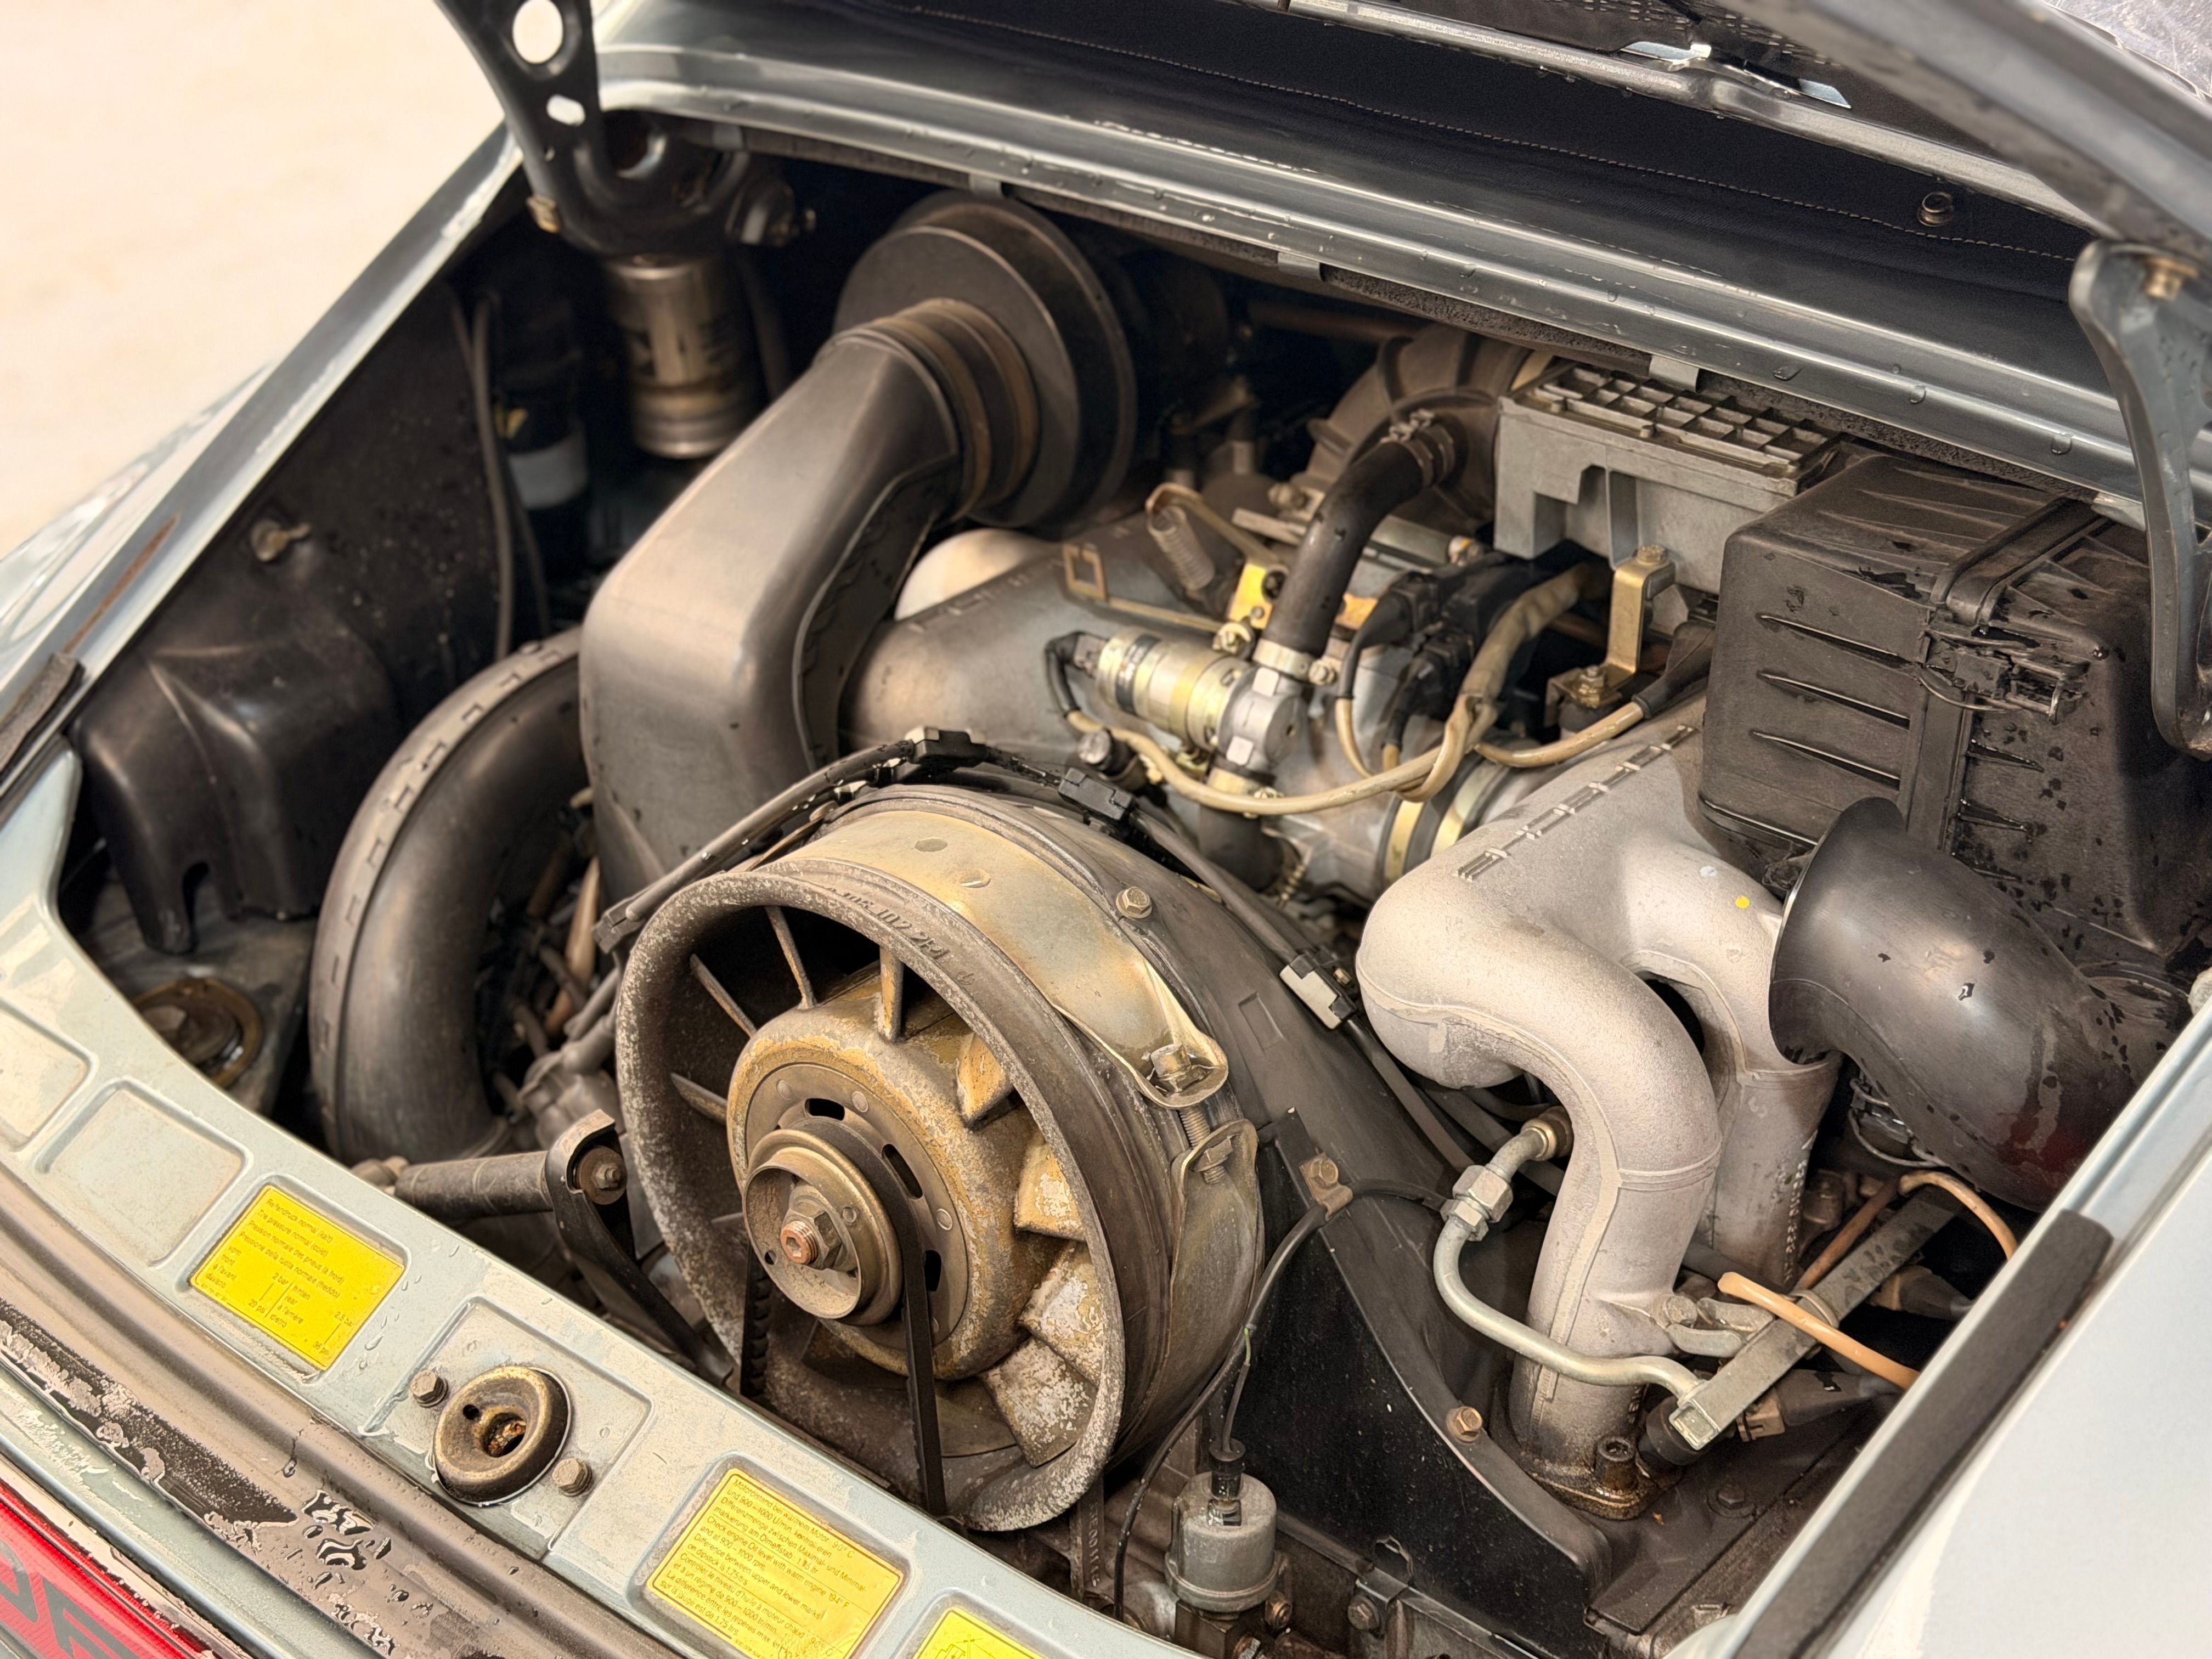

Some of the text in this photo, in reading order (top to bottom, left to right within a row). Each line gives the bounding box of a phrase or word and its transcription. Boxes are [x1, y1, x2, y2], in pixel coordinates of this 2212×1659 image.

[267, 1217, 291, 1234] pressure
[291, 1232, 312, 1246] normal
[298, 1219, 319, 1234] normal
[294, 1250, 304, 1259] des
[303, 1256, 322, 1270] pneus
[278, 1276, 289, 1285] bar
[284, 1295, 297, 1305] rear
[727, 1489, 741, 1500] und
[740, 1496, 753, 1507] 900
[701, 1526, 714, 1536] and
[719, 1537, 733, 1549] 900
[737, 1549, 753, 1561] 1000
[748, 1528, 759, 1537] am
[810, 1528, 830, 1542] Motor
[696, 1549, 720, 1566] dipstick
[719, 1562, 726, 1571] is
[707, 1516, 727, 1532] Check
[725, 1530, 748, 1547] engine
[748, 1542, 758, 1551] Oil
[757, 1549, 774, 1562] level
[772, 1559, 786, 1571] with
[786, 1568, 804, 1582] warm
[804, 1580, 826, 1596] engine
[768, 1528, 797, 1549] zwischen
[826, 1565, 840, 1576] und
[693, 1533, 823, 1620] Difference between upper and lower marks
[667, 1570, 676, 1580] La
[706, 1596, 723, 1611] entre
[722, 1607, 732, 1617] les
[671, 1586, 679, 1594] la
[676, 1592, 696, 1606] jauge
[695, 1604, 706, 1612] est
[702, 1609, 714, 1619] de
[714, 1577, 736, 1593] niveau
[761, 1608, 785, 1624] moteur
[715, 1590, 725, 1599] de
[724, 1595, 738, 1607] 900
[742, 1607, 759, 1621] 1000
